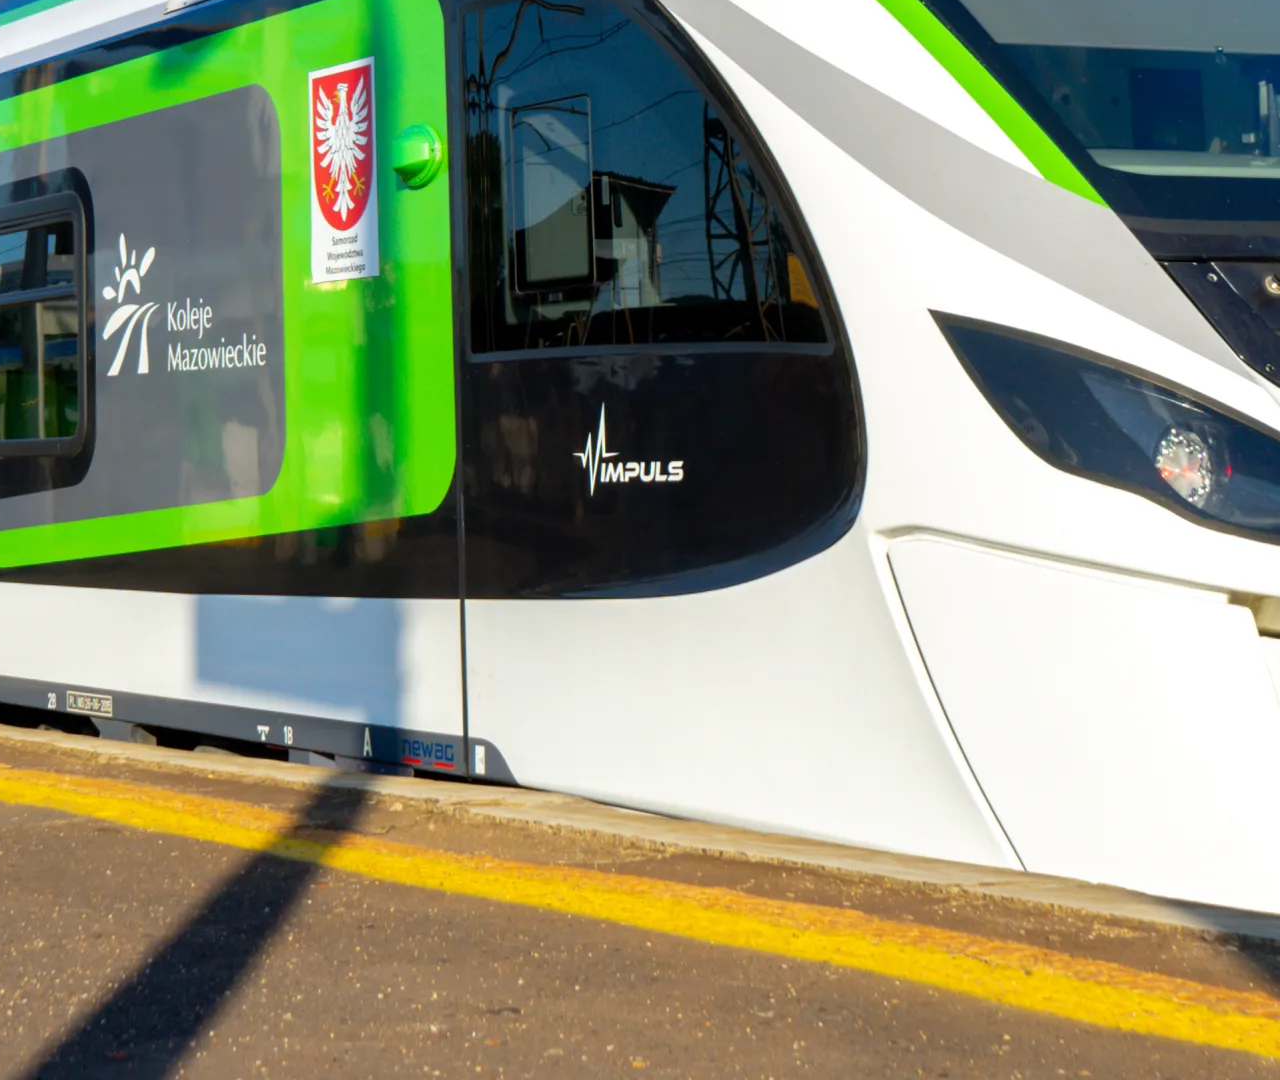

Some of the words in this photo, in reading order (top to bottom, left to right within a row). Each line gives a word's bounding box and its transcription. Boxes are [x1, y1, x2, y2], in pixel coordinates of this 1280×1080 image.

[167, 297, 213, 339] Koleje
[167, 333, 267, 372] Mazowieckie
[600, 460, 685, 483] IMPULS
[283, 724, 294, 746] 1B
[363, 726, 373, 758] A
